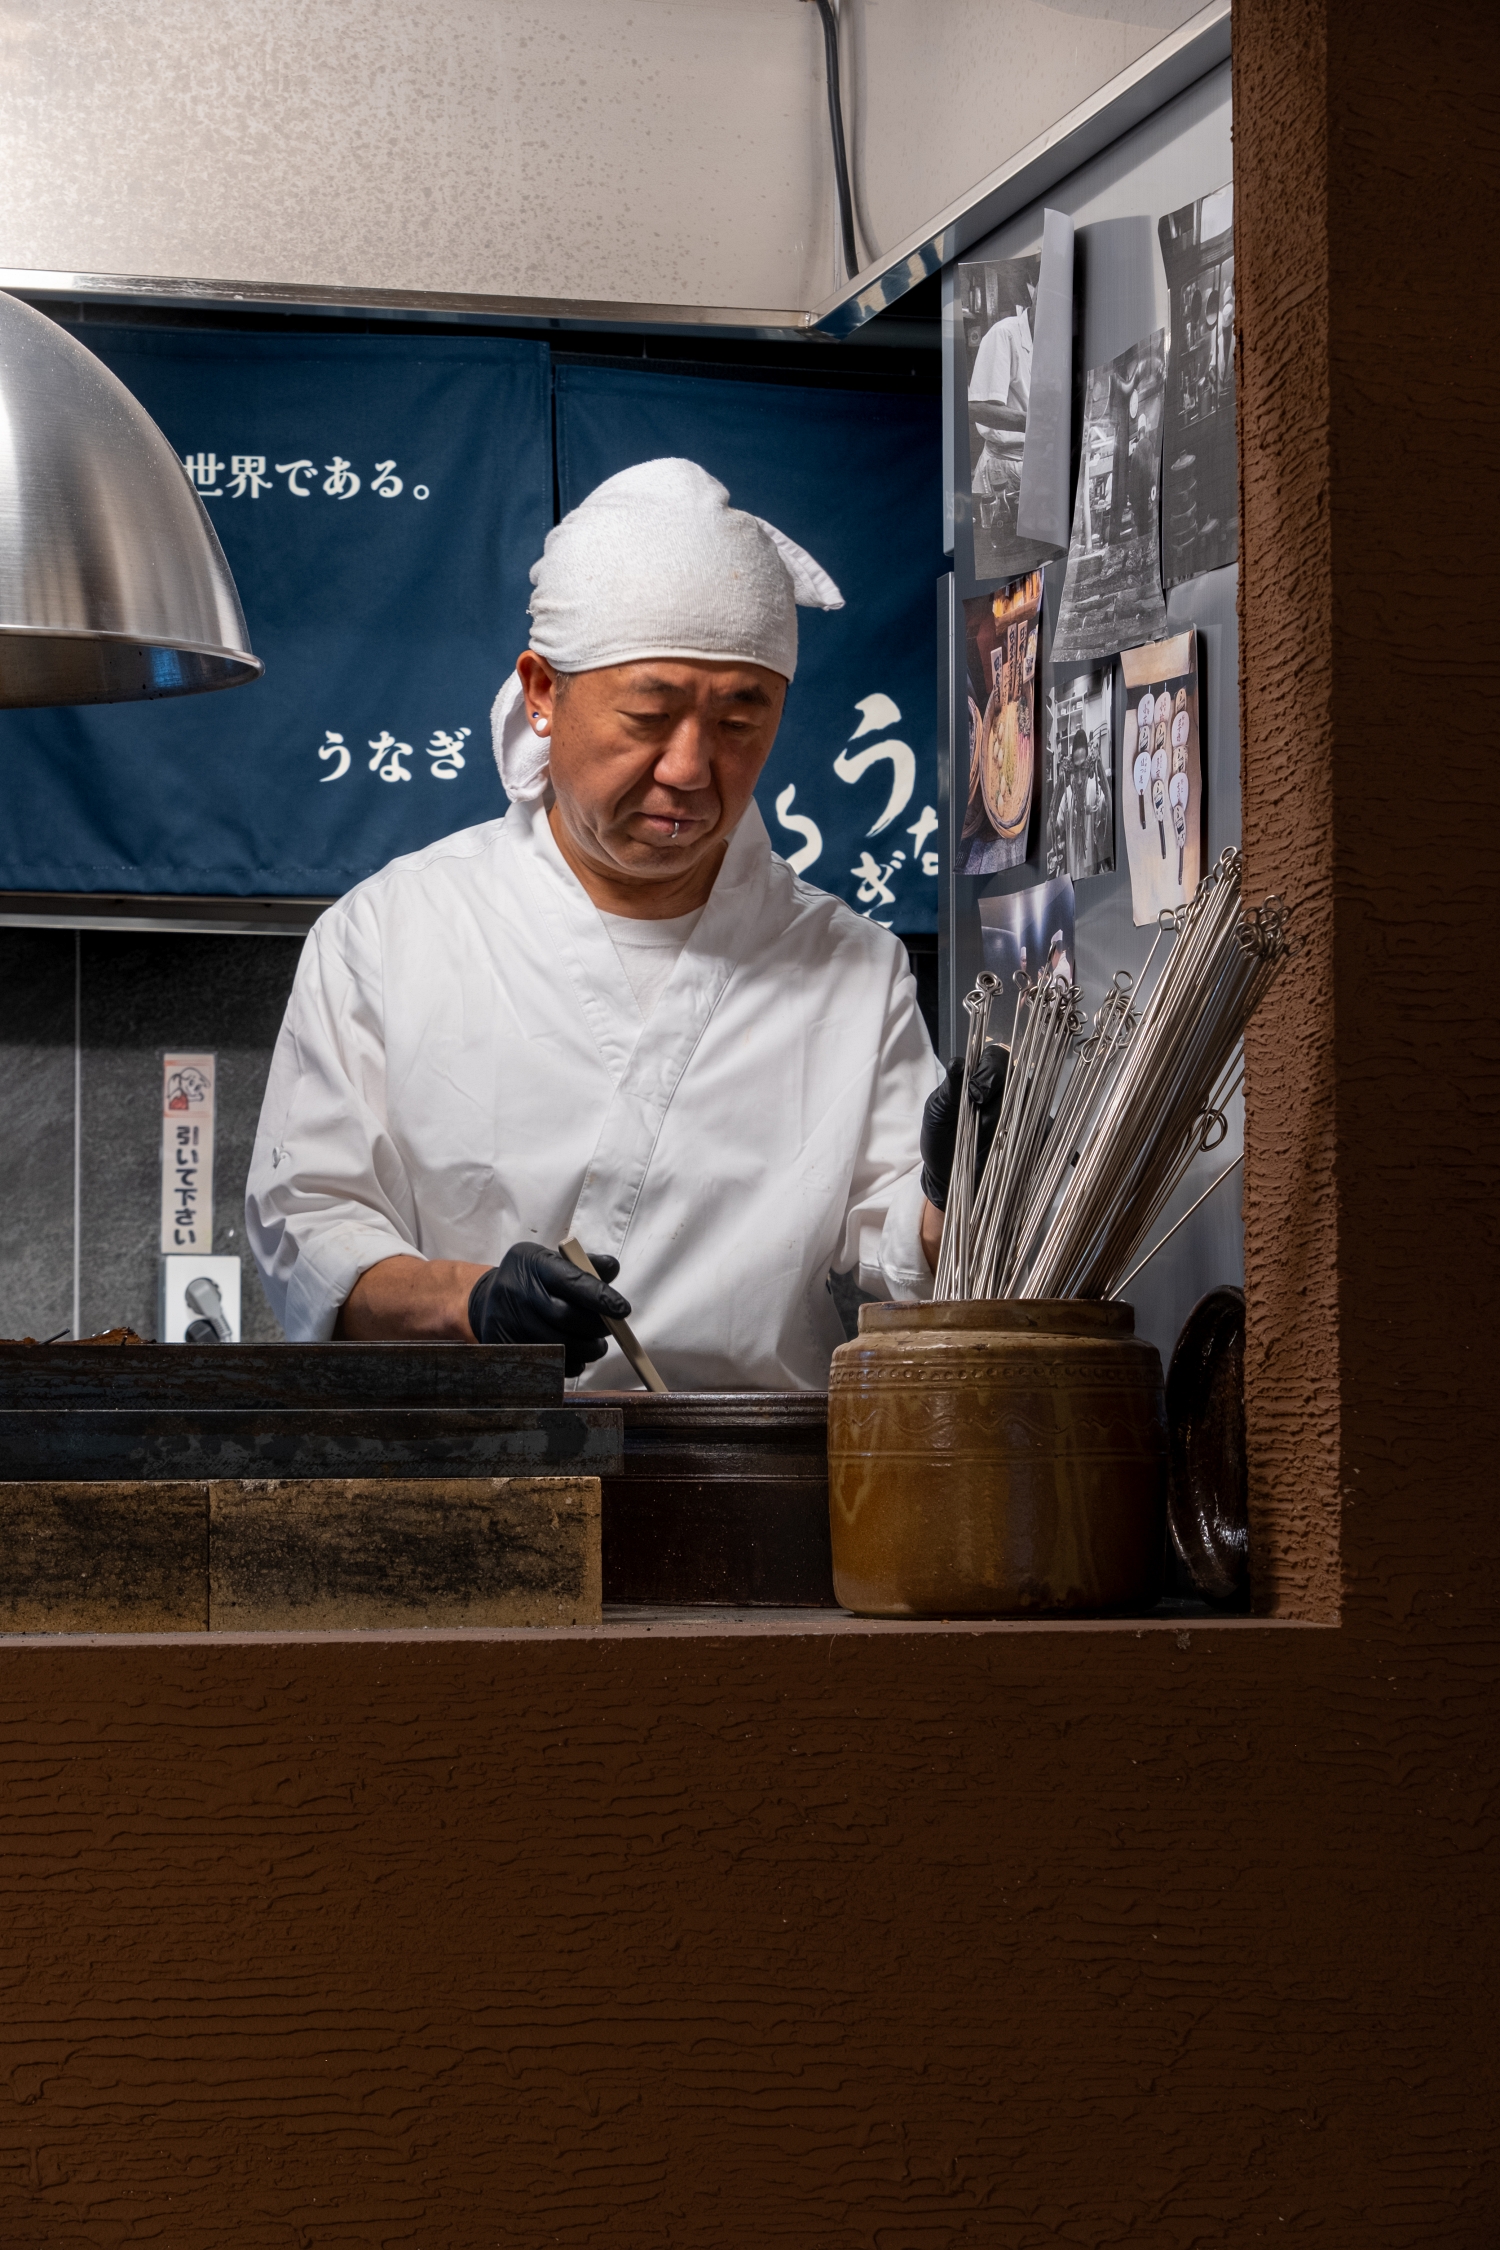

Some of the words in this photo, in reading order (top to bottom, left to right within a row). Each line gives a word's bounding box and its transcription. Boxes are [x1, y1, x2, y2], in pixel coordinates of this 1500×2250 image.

[185, 452, 430, 500] 世界である。
[318, 727, 472, 783] うなぎ
[174, 1125, 199, 1245] 引いて下さい
